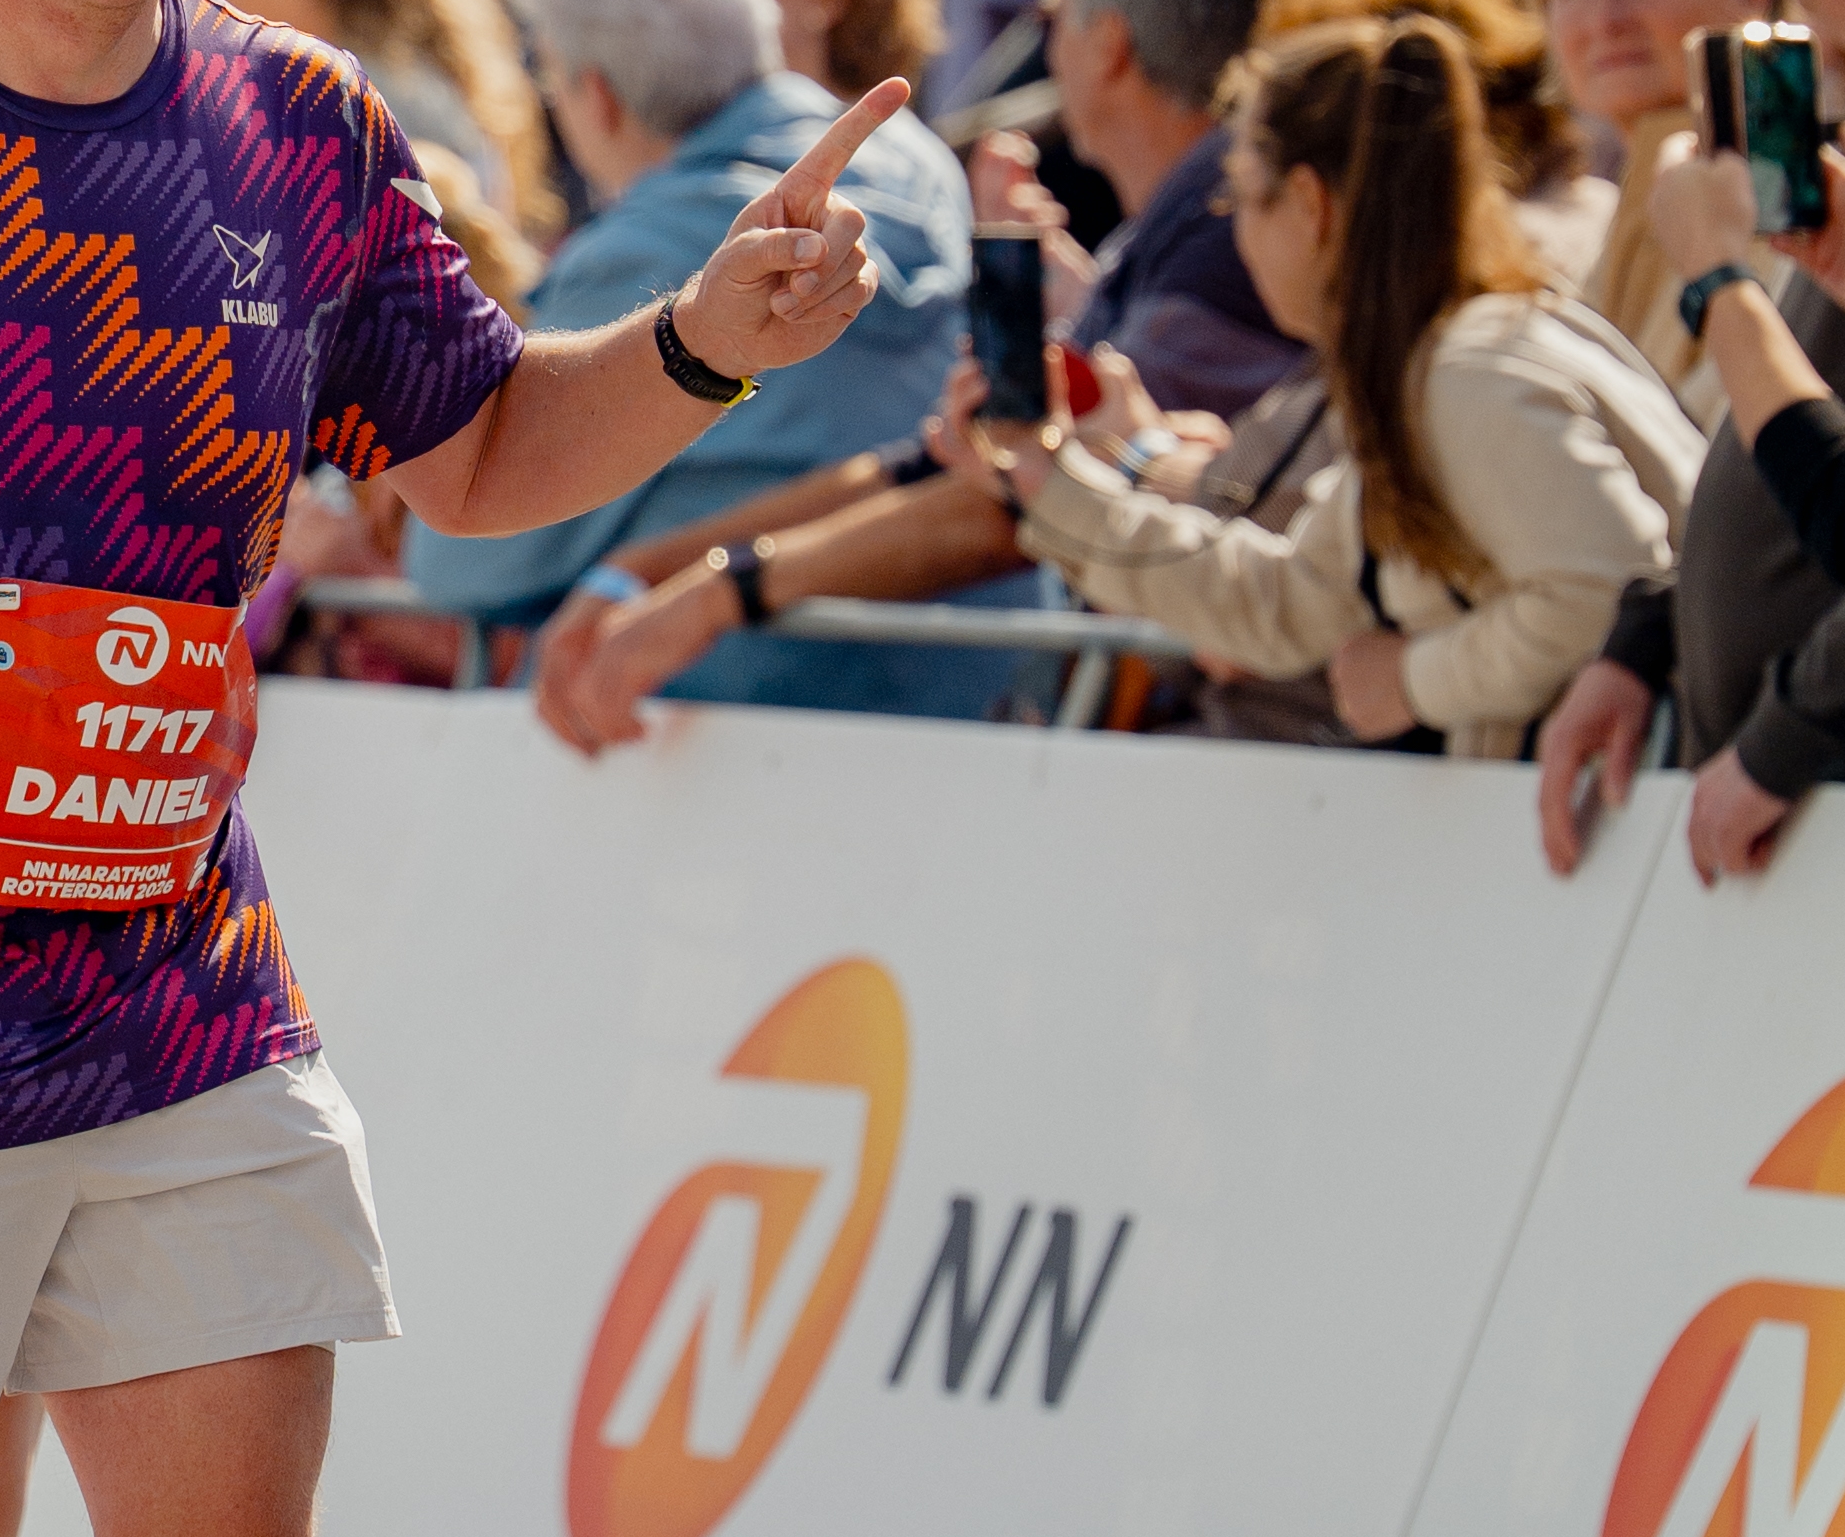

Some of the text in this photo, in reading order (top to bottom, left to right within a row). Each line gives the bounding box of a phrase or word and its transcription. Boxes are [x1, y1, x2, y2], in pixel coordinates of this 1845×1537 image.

[221, 299, 278, 327] KLABU
[181, 639, 227, 668] NN
[76, 701, 215, 754] 11717
[4, 765, 210, 825] DANIEL
[22, 859, 172, 883] NN MARATHON
[1, 876, 176, 901] ROTTERDAM 2026
[888, 1191, 1133, 1409] NN
